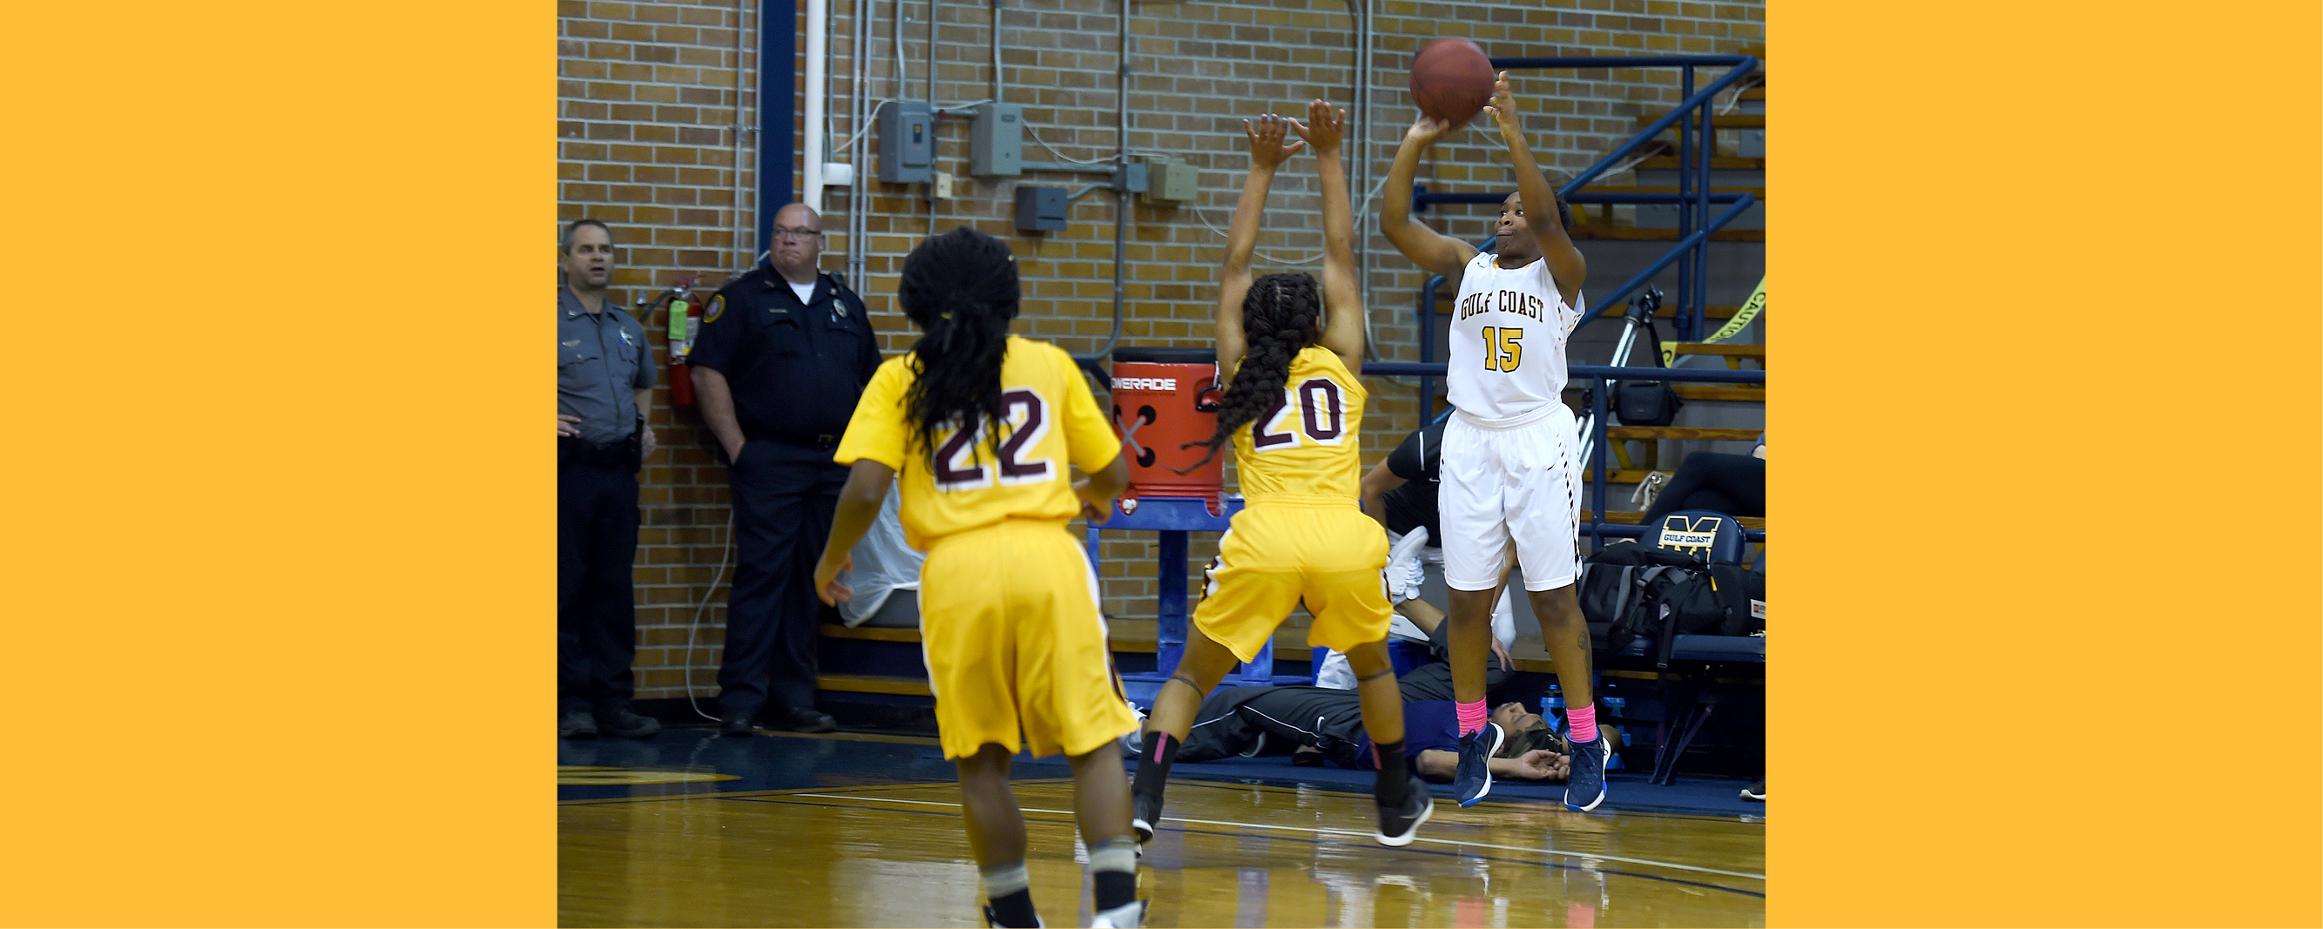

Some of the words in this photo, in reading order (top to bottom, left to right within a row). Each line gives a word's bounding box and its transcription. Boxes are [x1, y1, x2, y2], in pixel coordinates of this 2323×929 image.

[1460, 291, 1494, 321] GULF
[1498, 289, 1544, 323] COAST
[1481, 325, 1524, 373] 15
[1252, 377, 1347, 452] 20
[933, 387, 1056, 492] 22
[1663, 533, 1685, 542] GULF
